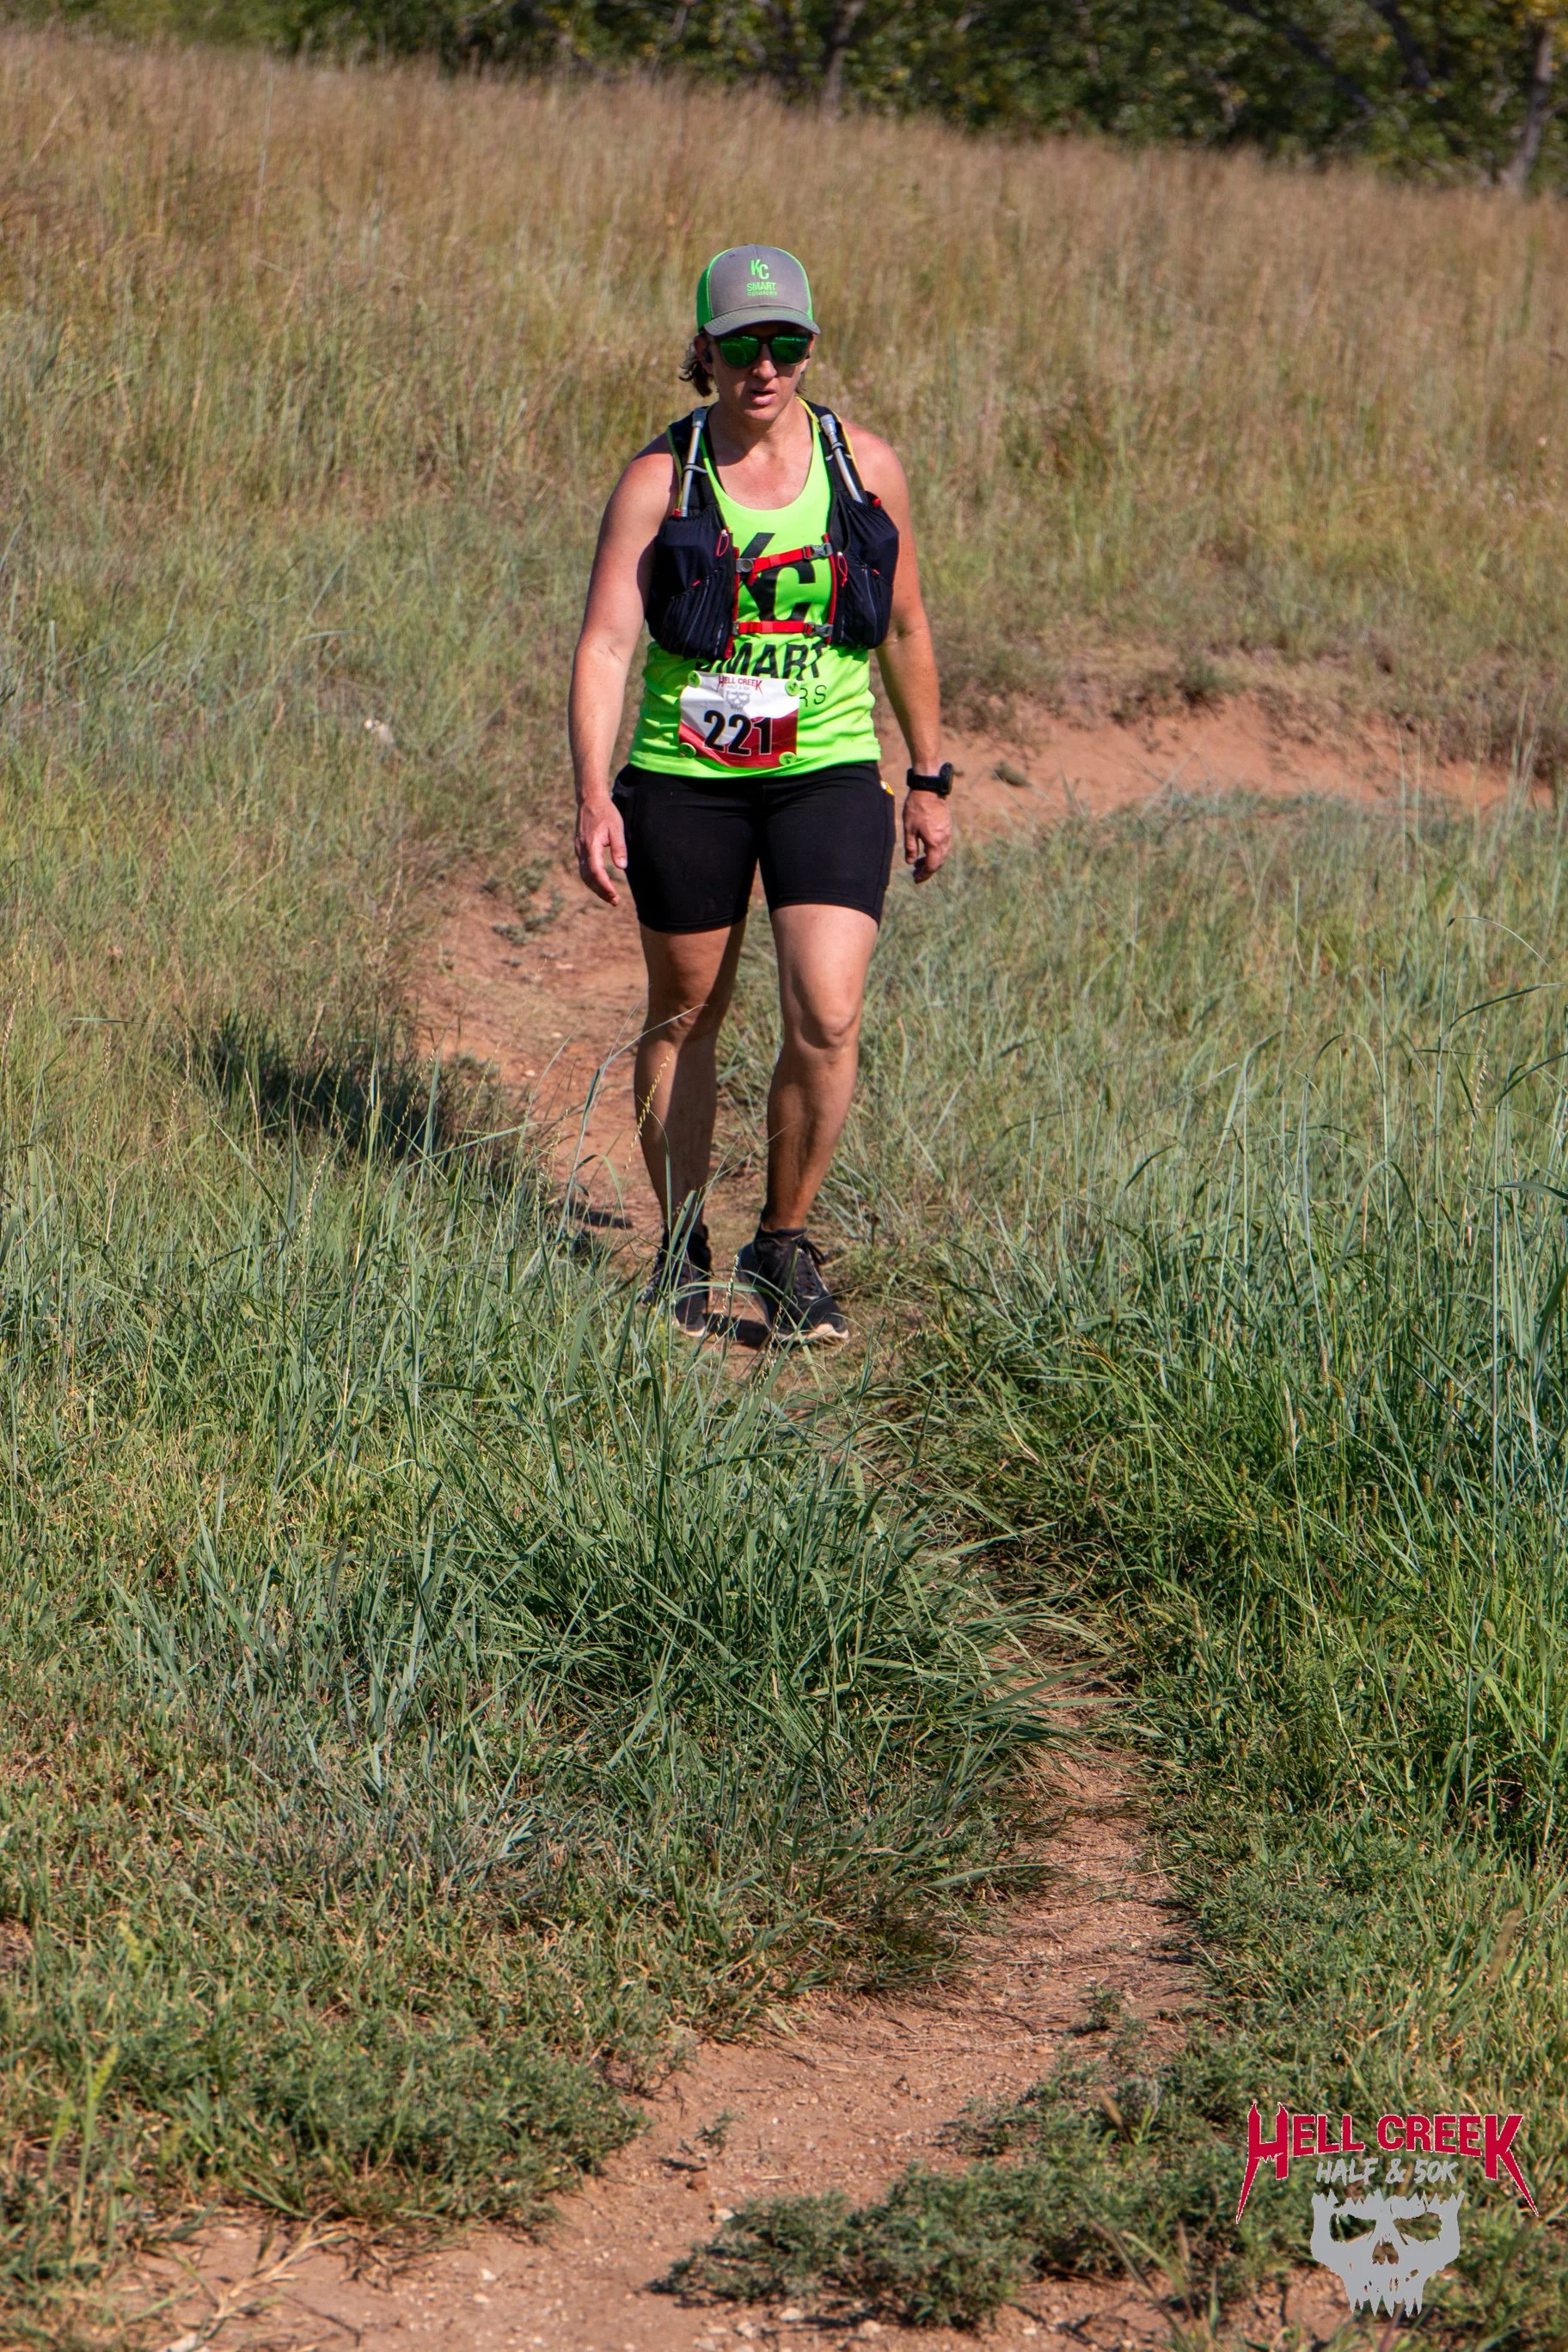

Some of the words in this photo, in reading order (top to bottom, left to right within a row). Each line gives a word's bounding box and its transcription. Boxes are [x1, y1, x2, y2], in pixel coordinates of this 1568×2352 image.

[750, 259, 770, 280] KC
[746, 281, 778, 291] SMART
[716, 675, 736, 692] HELL
[738, 677, 763, 695] CREEK
[703, 710, 772, 756] 221
